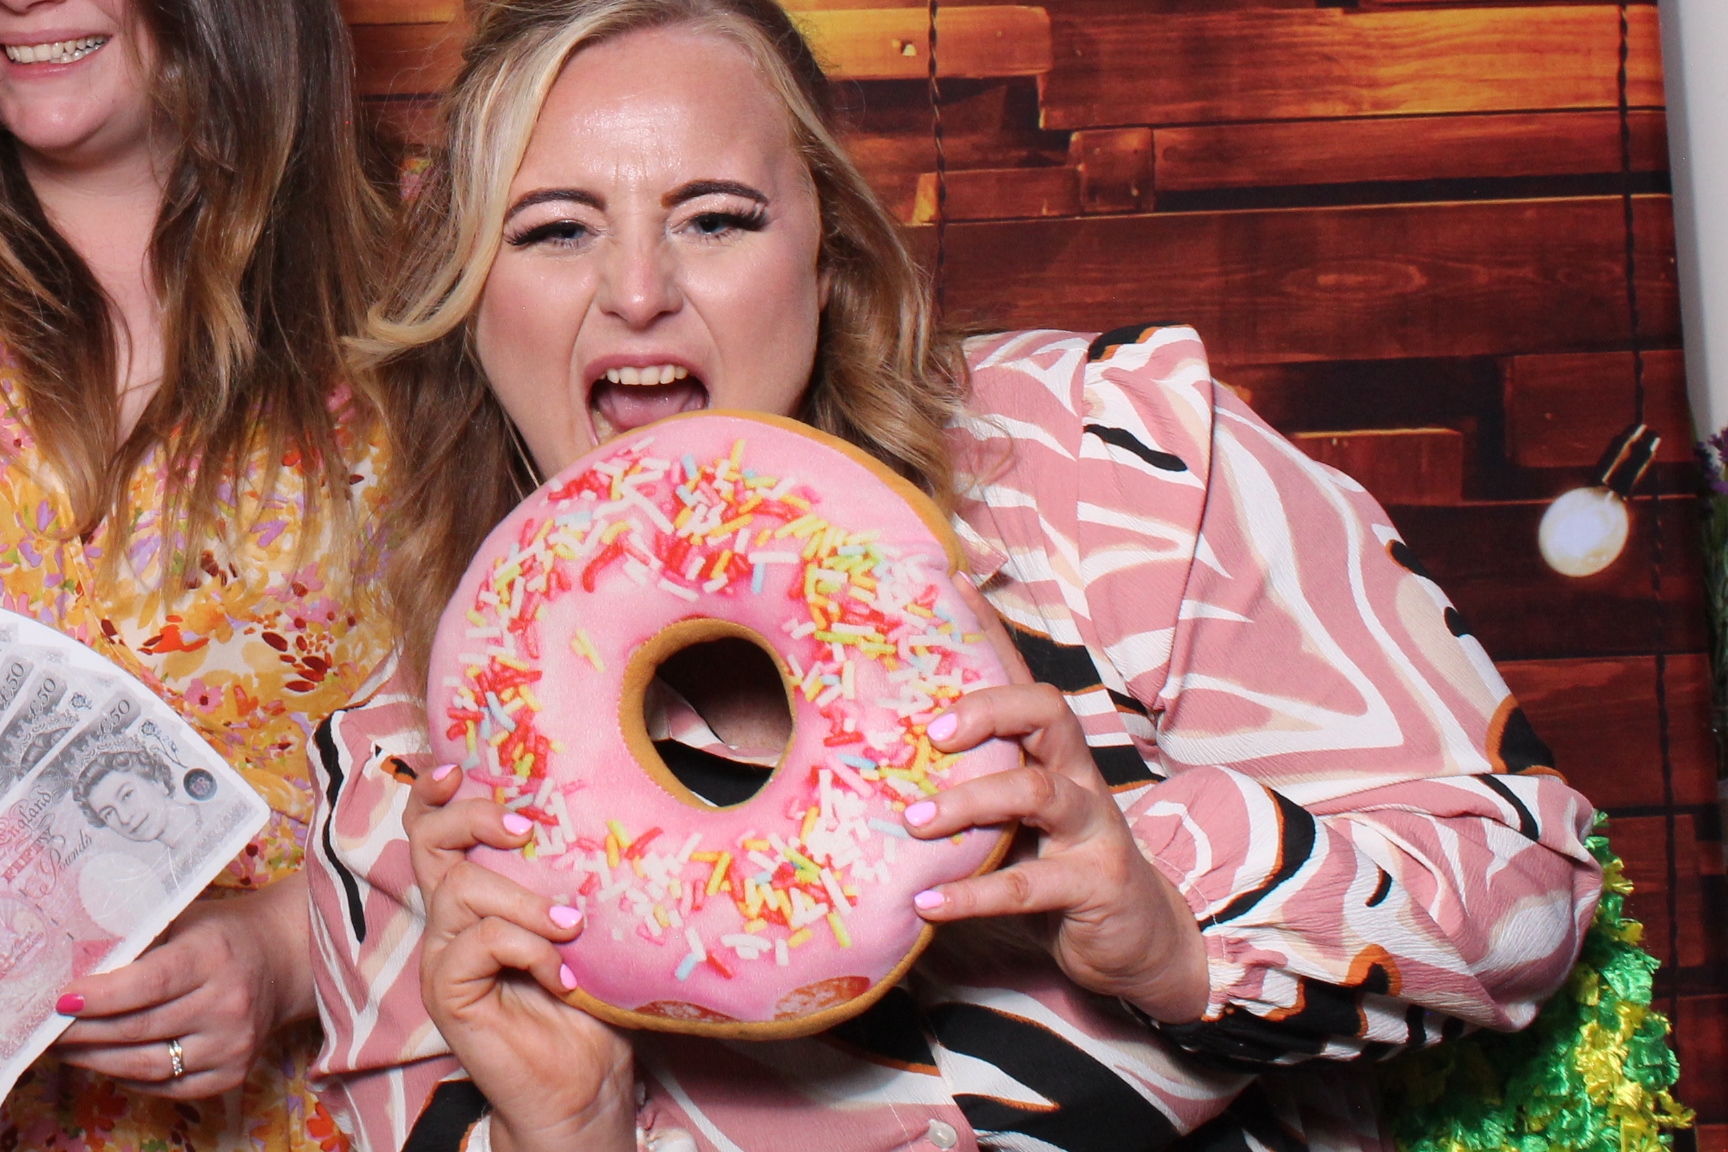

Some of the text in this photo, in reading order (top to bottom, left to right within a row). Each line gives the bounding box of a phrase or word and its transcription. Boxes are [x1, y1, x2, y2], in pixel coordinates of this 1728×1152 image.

[0, 661, 25, 705] £50
[28, 677, 57, 719] £50
[96, 699, 131, 736] £50
[1, 826, 55, 885] FIFTY
[25, 829, 93, 898] Pounds
